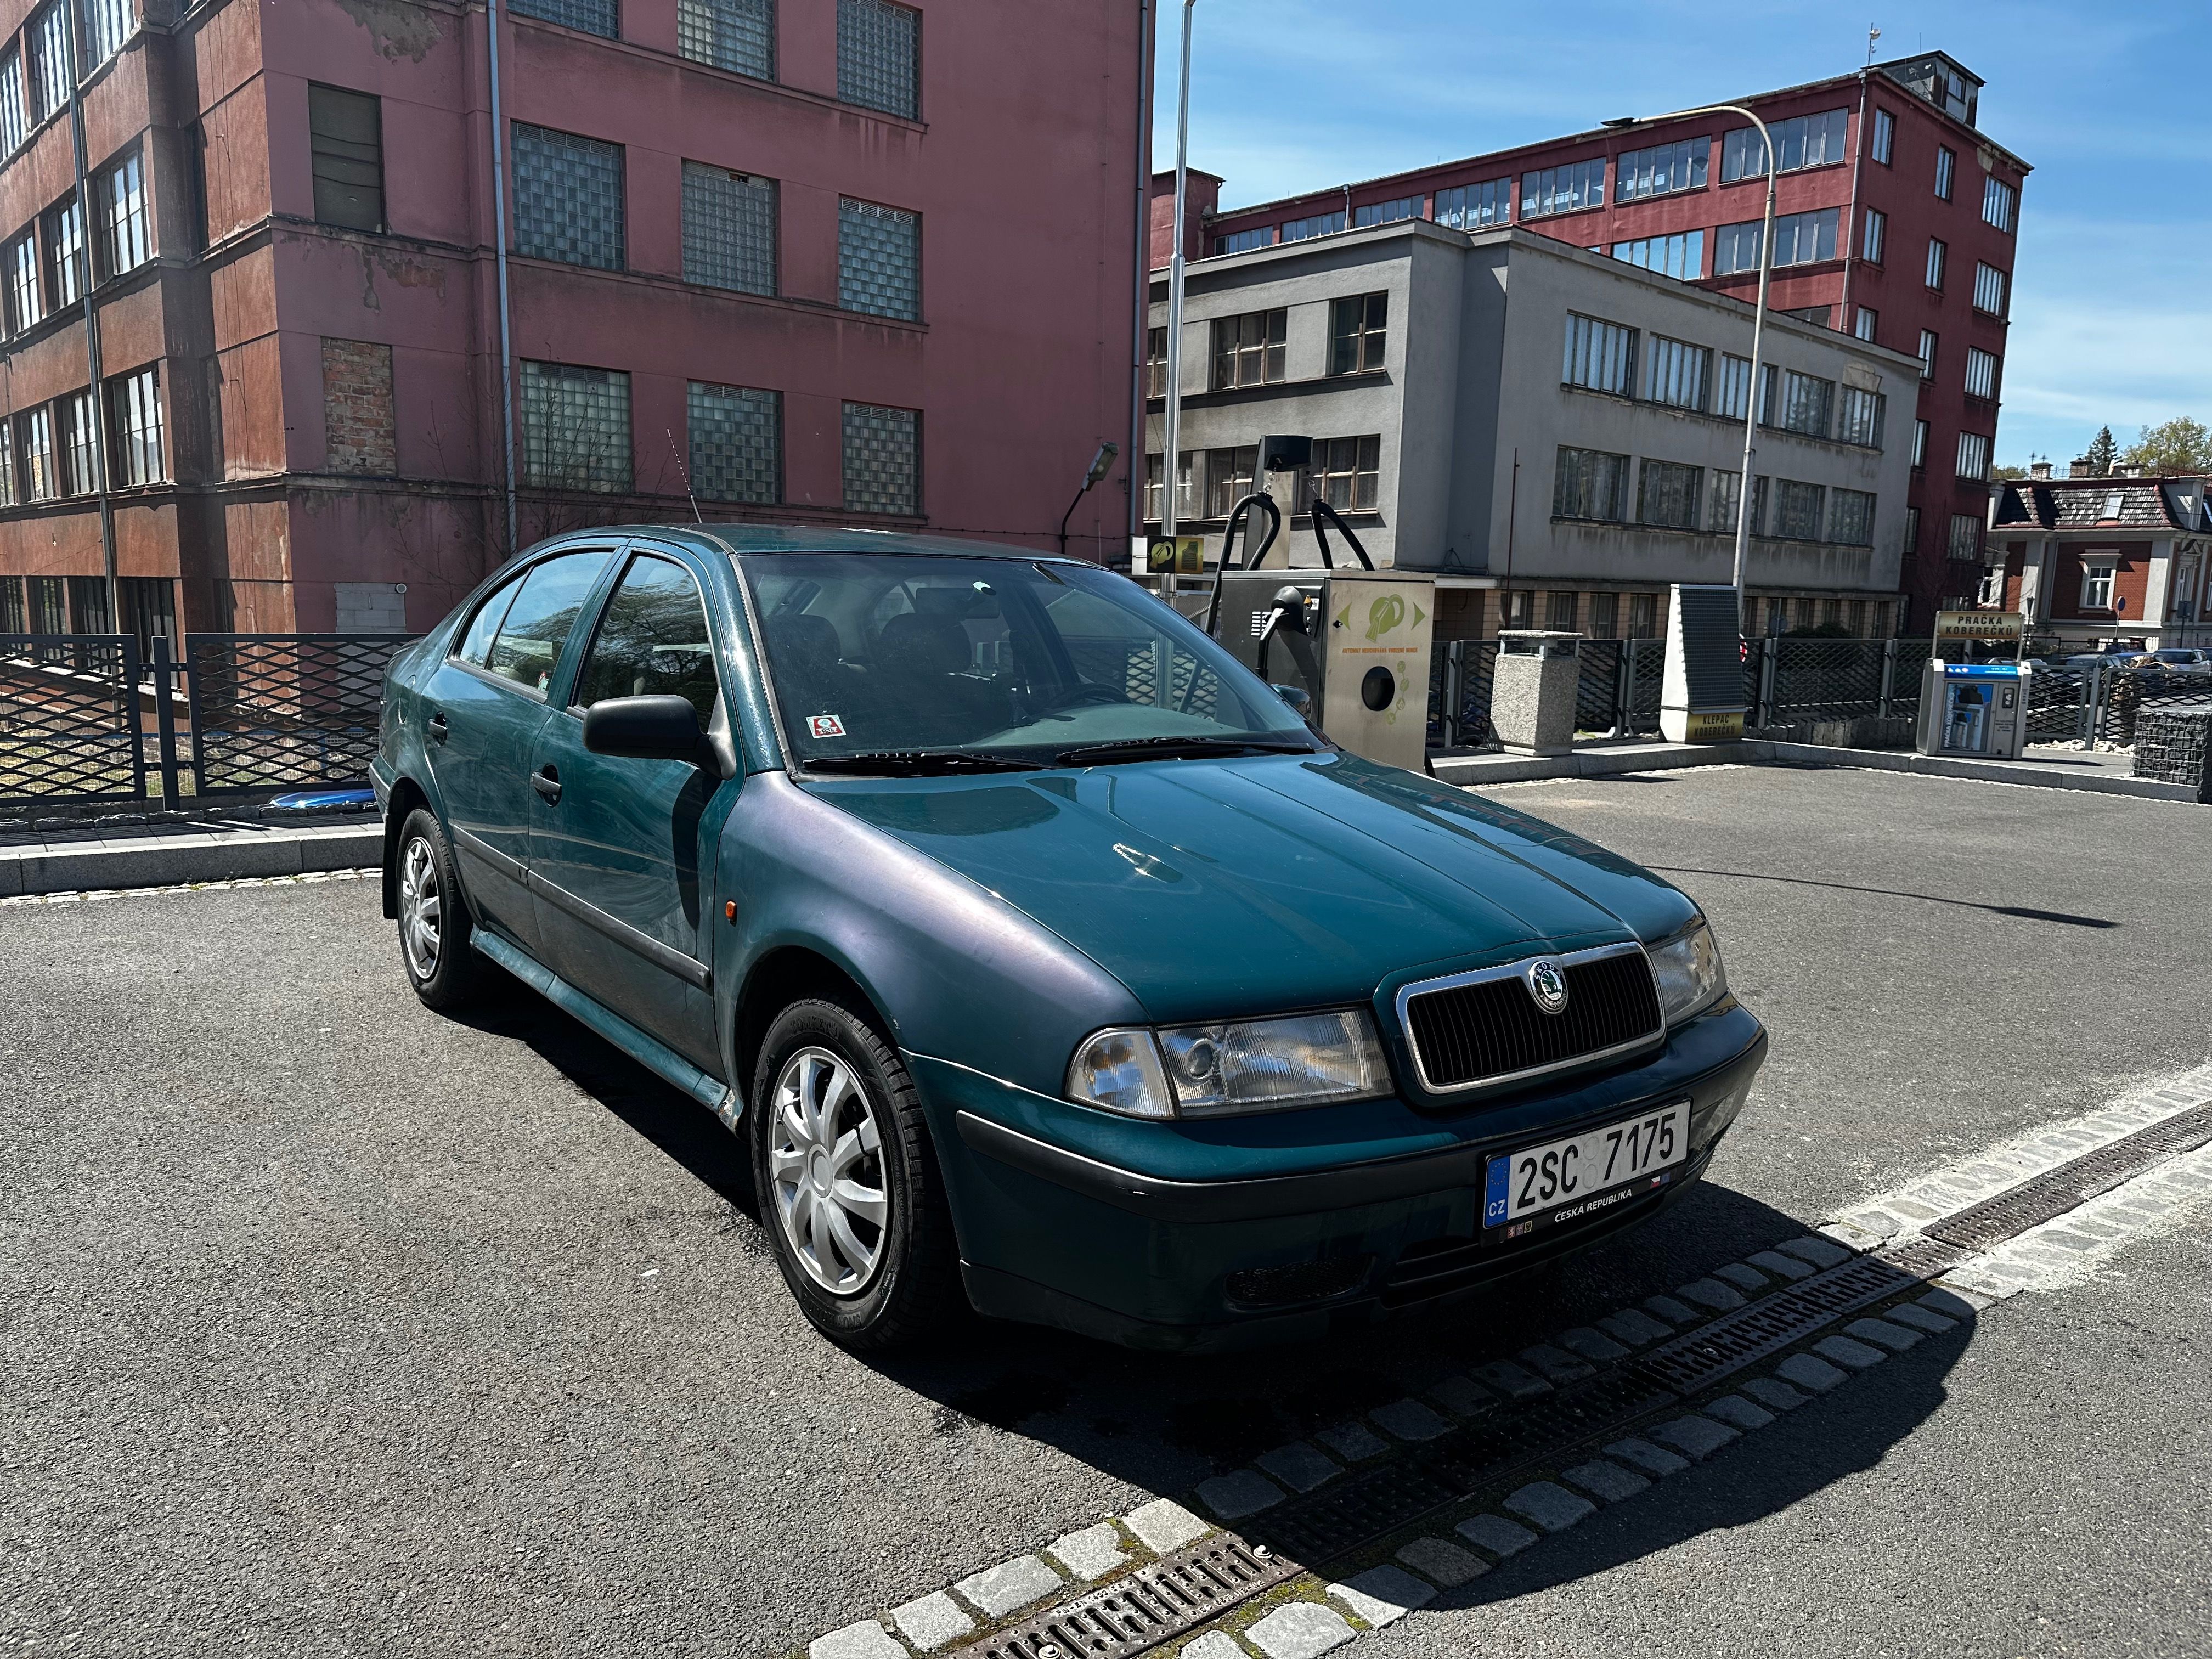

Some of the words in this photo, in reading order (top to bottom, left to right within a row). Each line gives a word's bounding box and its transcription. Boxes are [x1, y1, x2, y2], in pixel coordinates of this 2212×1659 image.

[1957, 614, 2002, 625] PRAČKA
[1945, 625, 2013, 636] KOBEREČKŮ
[1694, 724, 1735, 737] KOBEREČKŮ
[1517, 1145, 1578, 1209] 2SC
[1604, 1111, 1676, 1181] 7175
[1489, 1199, 1505, 1217] CZ
[1554, 1205, 1584, 1223] ČESKÁ
[1586, 1188, 1633, 1212] REPUBLIKA
